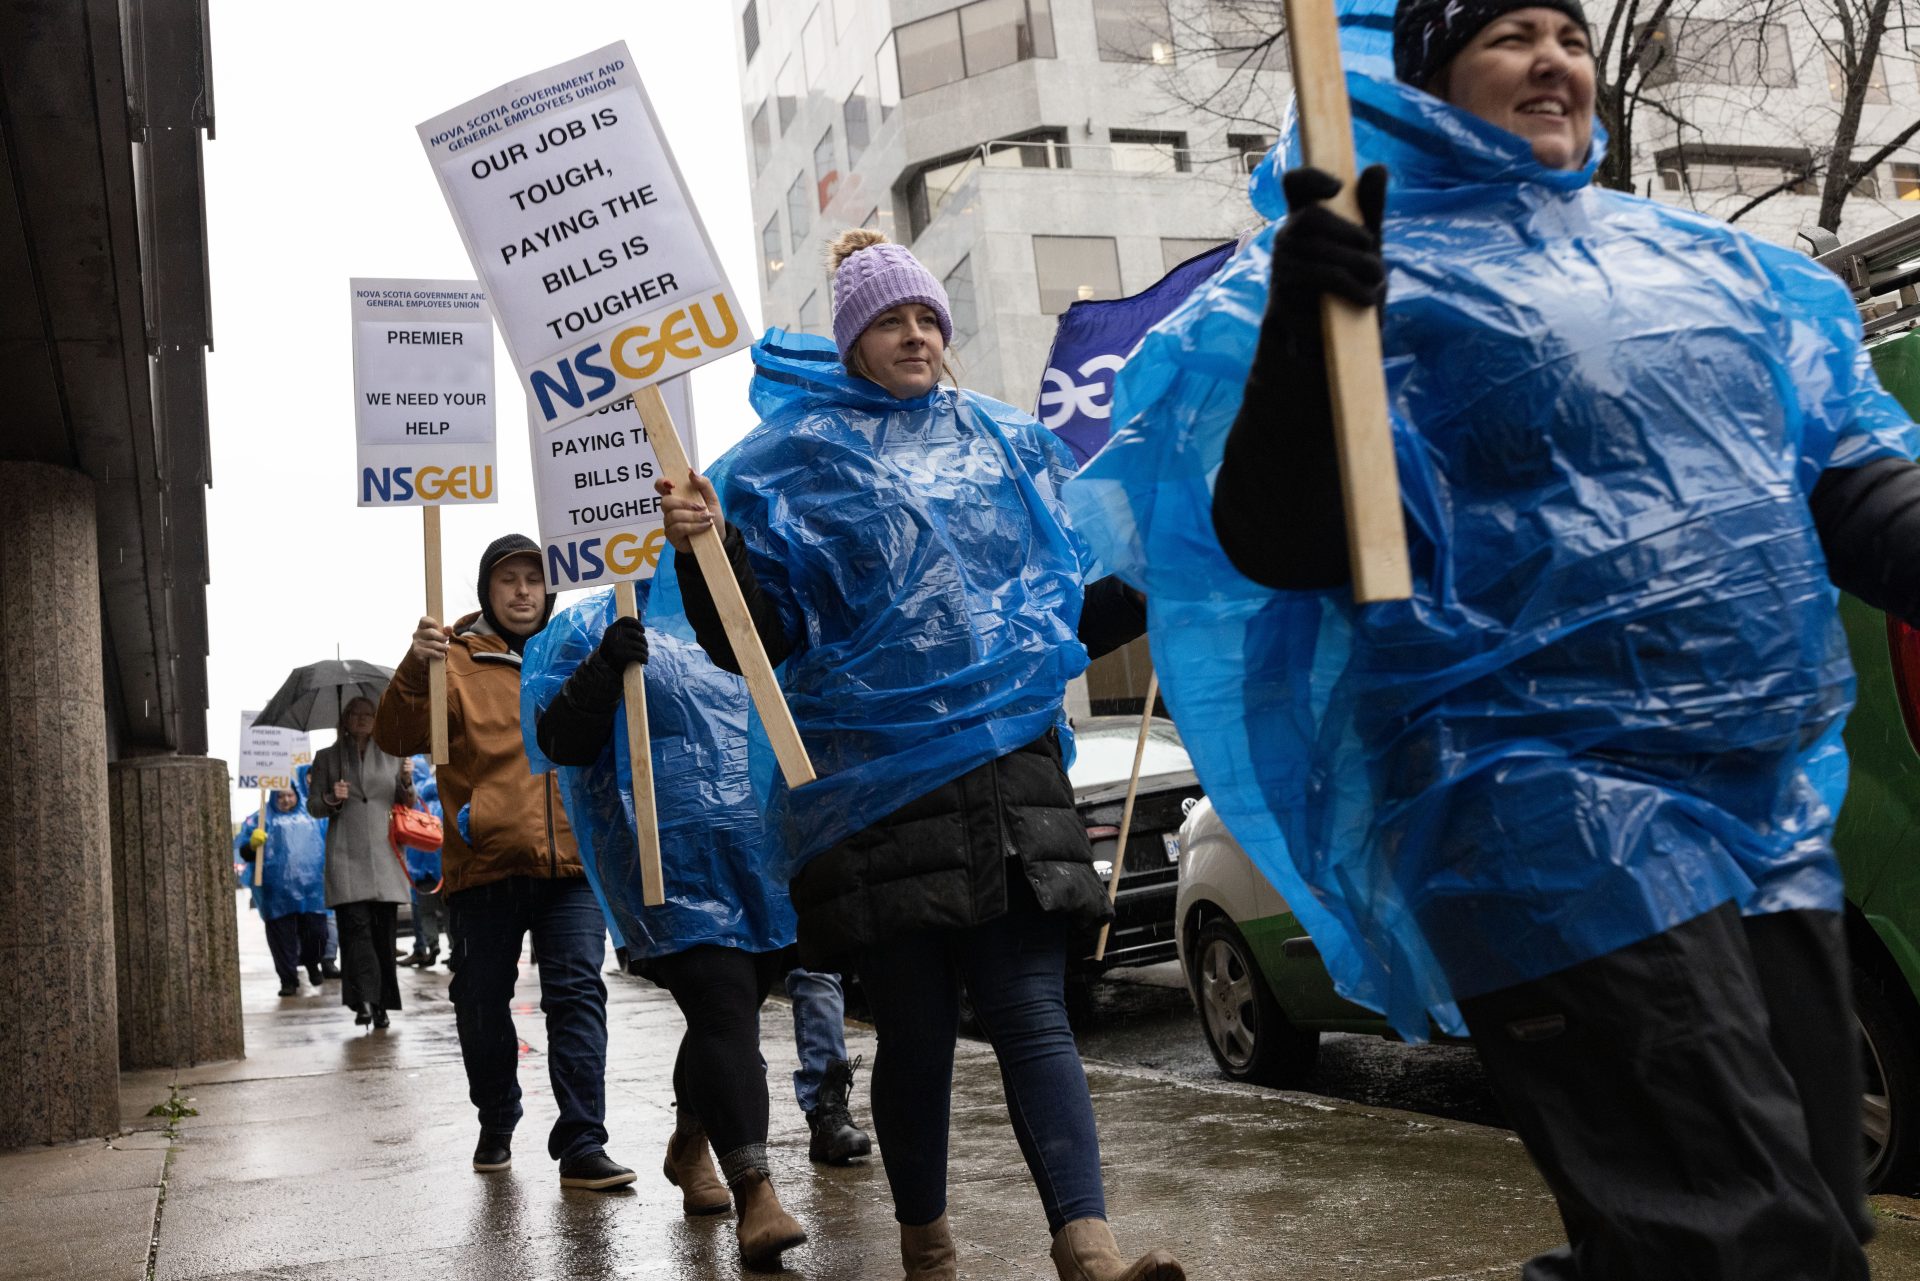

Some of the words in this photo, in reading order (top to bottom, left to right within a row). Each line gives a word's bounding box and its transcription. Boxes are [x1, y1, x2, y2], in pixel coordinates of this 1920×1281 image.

[430, 125, 465, 147] NOVA
[467, 105, 509, 131] SCOTIA
[511, 71, 594, 110] GOVERNMENT
[598, 60, 625, 78] AND
[448, 123, 503, 152] GENERAL
[504, 94, 574, 127] EMPLOYEES
[576, 76, 617, 99] UNION
[471, 142, 529, 180] OUR
[535, 119, 587, 154] JOB
[591, 107, 619, 131] IS
[509, 158, 613, 211] TOUGH,
[500, 209, 599, 265] PAYING
[601, 184, 658, 219] THE
[542, 248, 618, 294] BILLS
[622, 235, 649, 260] IS
[356, 290, 381, 299] NOVA
[382, 290, 412, 299] SCOTIA
[413, 291, 469, 300] GOVERNMENT
[366, 299, 405, 308] GENERAL
[406, 300, 452, 309] EMPLOYEES
[453, 300, 480, 309] UNION
[547, 272, 679, 340] TOUGHER
[387, 330, 464, 345] PREMIER
[529, 292, 739, 422] NSGEU
[366, 393, 391, 406] WE
[396, 393, 439, 406] NEED
[443, 393, 487, 406] YOUR
[405, 421, 450, 436] HELP
[552, 431, 625, 458] PAYING
[362, 465, 493, 503] NSGEU
[574, 465, 630, 489] BILLS
[635, 462, 654, 480] IS
[547, 527, 666, 586] NSGE
[239, 775, 289, 789] NSGEU
